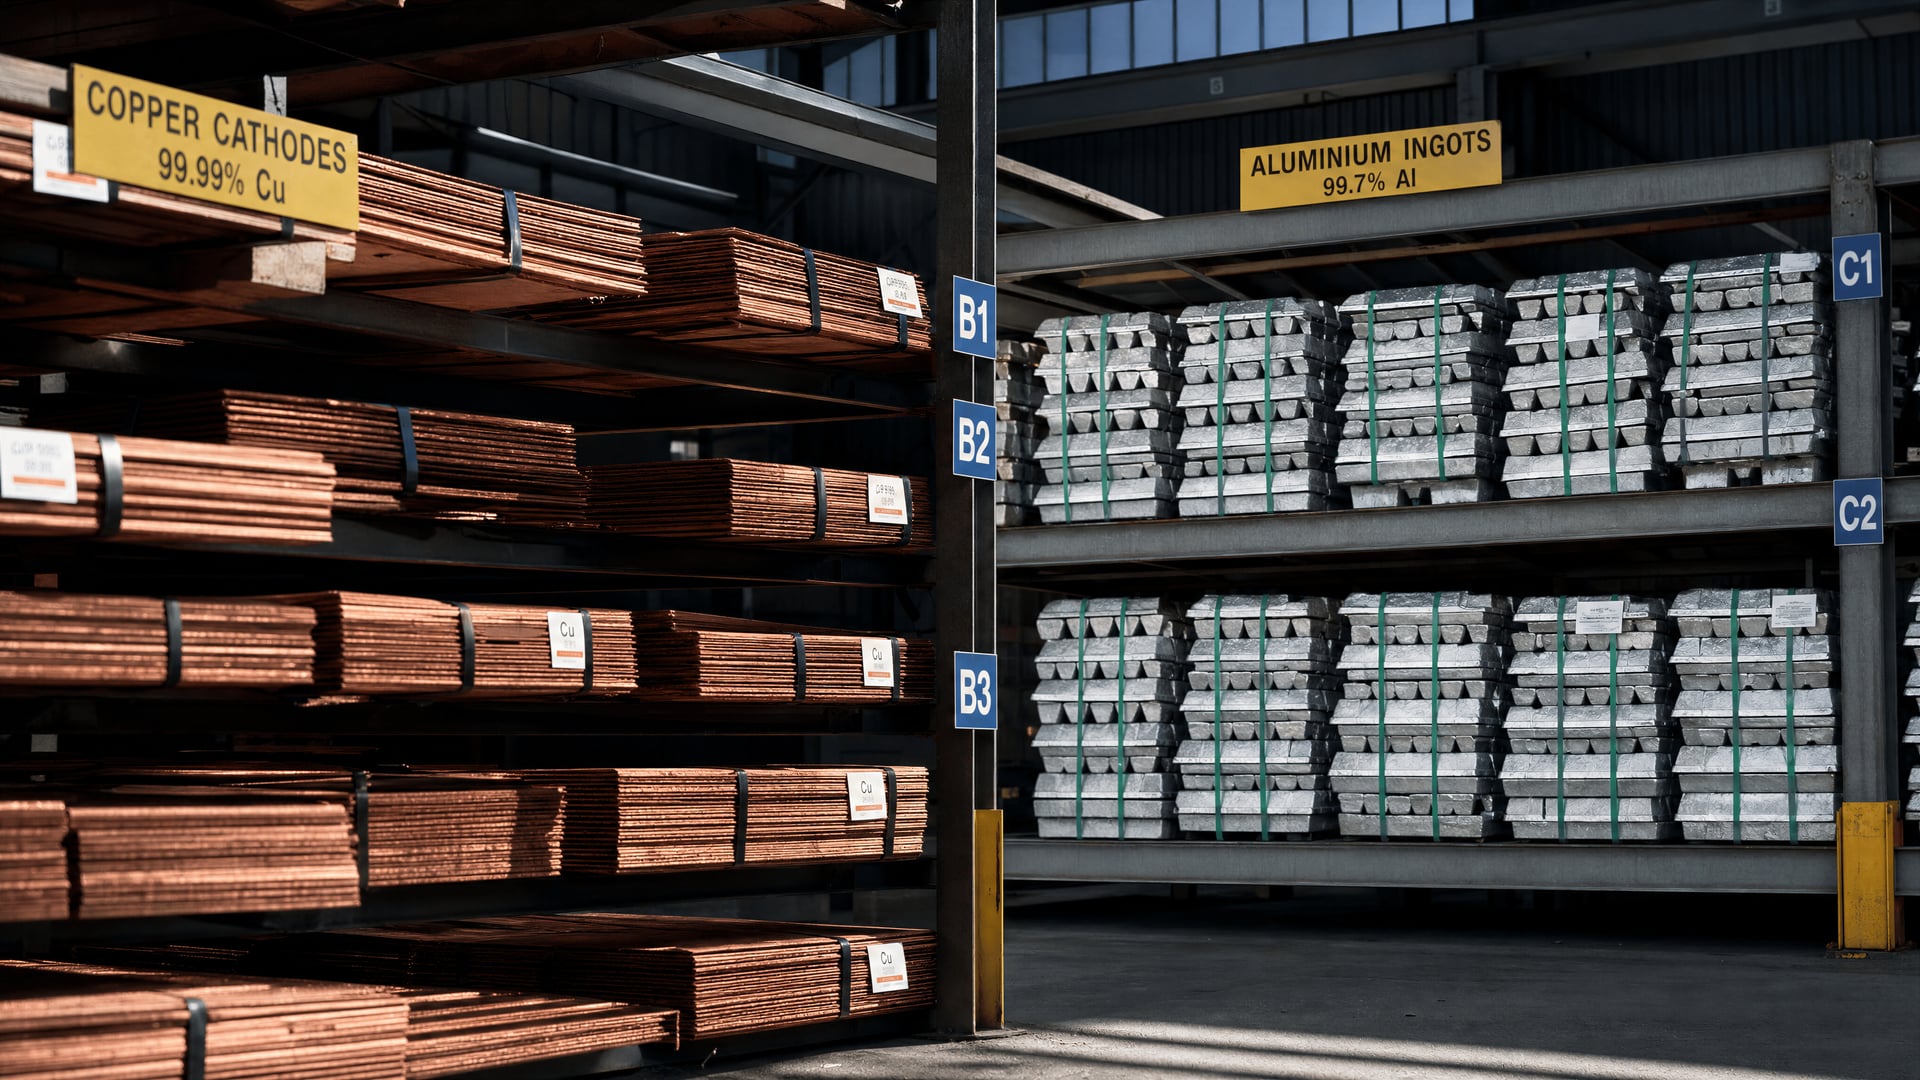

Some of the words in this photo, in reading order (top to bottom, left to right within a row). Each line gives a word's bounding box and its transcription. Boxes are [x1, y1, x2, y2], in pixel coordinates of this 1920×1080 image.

[87, 80, 200, 140] COPPER
[213, 112, 347, 174] CATHODES
[1250, 140, 1391, 177] ALUMINIUM
[1404, 128, 1491, 161] INGOTS
[158, 147, 245, 196] 99.99%
[256, 168, 286, 204] Cu
[1322, 171, 1385, 197] 99.7%
[1839, 249, 1873, 287] C1
[959, 293, 988, 344] B1
[959, 416, 990, 465] B2
[1839, 494, 1877, 532] C2
[559, 621, 575, 638] Cu
[871, 647, 883, 661] Cu
[960, 668, 992, 716] B3
[860, 780, 873, 794] Cu
[880, 951, 893, 965] Cu
